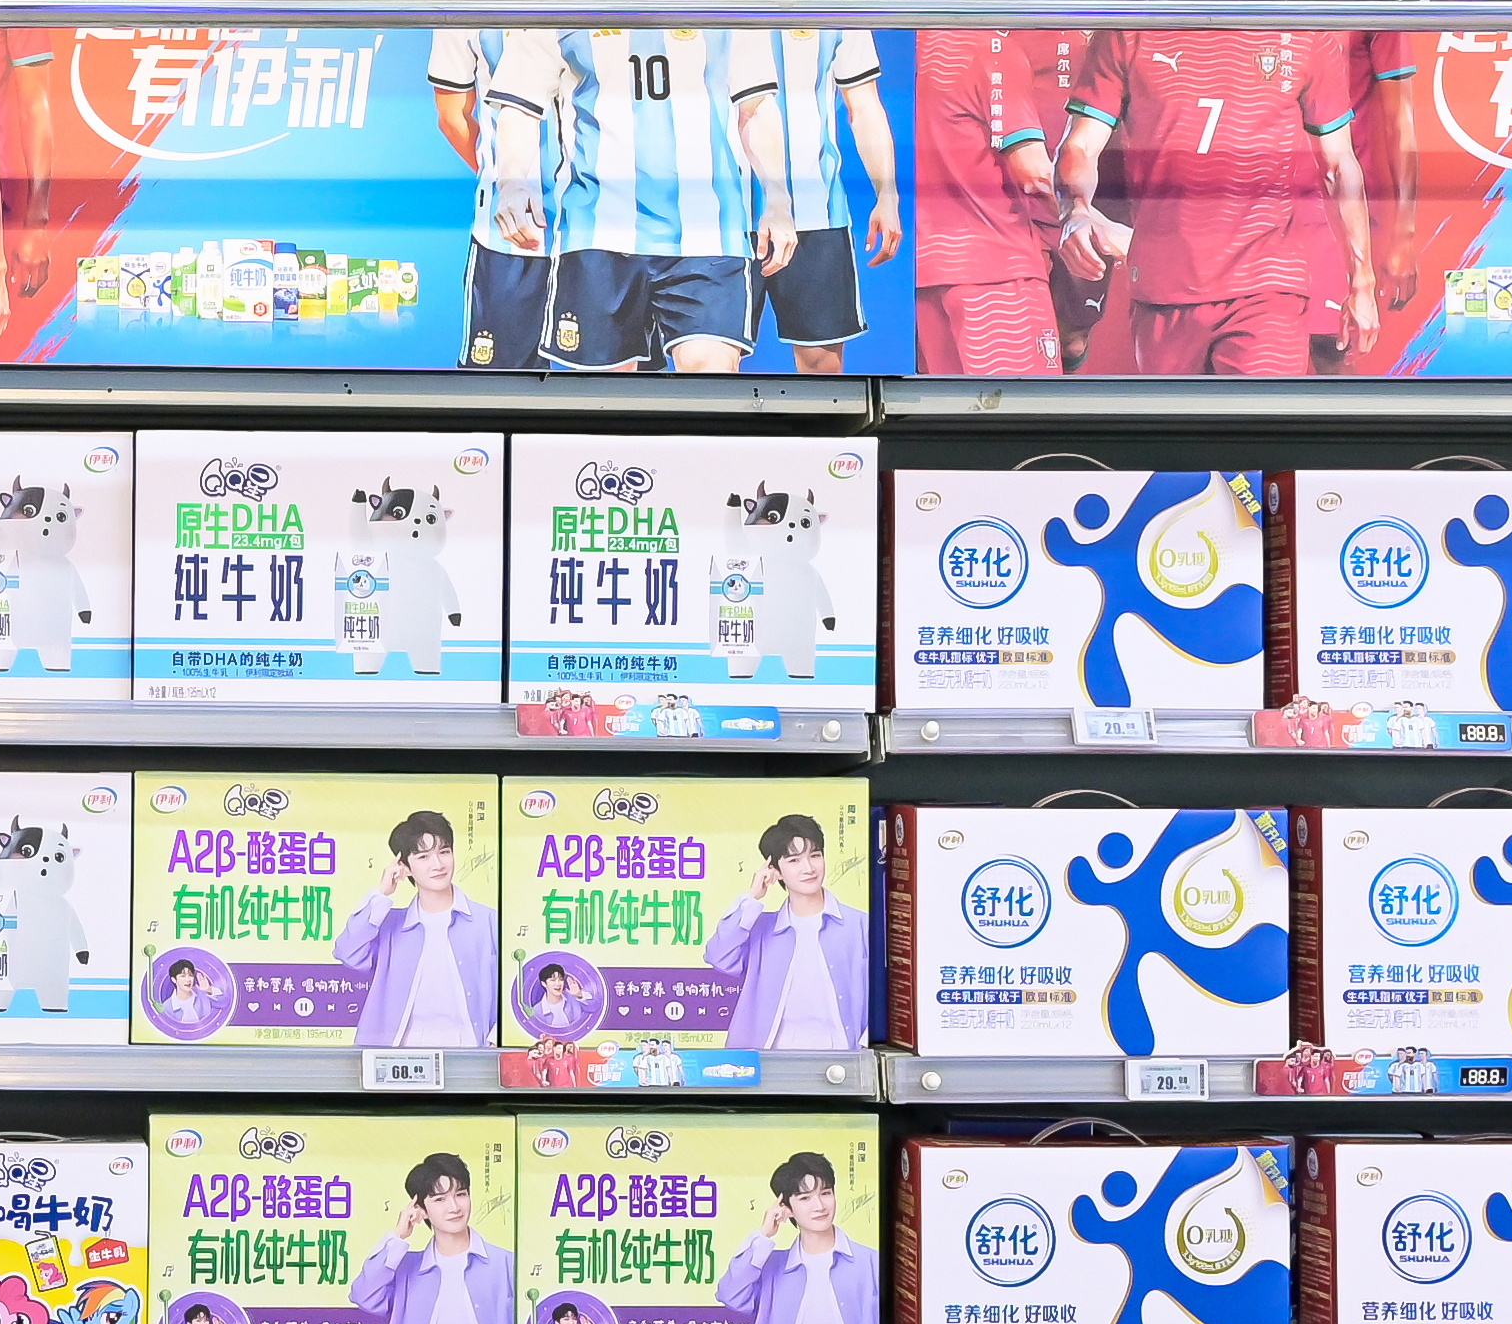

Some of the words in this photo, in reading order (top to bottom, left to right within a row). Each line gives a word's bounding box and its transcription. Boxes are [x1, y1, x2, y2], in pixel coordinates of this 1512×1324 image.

[127, 46, 369, 131] 有伊利
[630, 55, 671, 102] 10
[1195, 99, 1225, 155] 7
[946, 544, 1010, 581] 舒化
[1347, 544, 1411, 581] 舒化
[548, 557, 680, 628] 纯牛奶
[918, 626, 993, 646] 营养细化
[997, 626, 1050, 646] 好吸收
[172, 886, 333, 943] 有机纯牛奶
[968, 882, 1034, 919] 舒化
[1375, 882, 1441, 919] 舒化
[86, 1242, 129, 1266] 生牛乳
[188, 1228, 350, 1288] 有机纯牛奶
[553, 1228, 715, 1288] 有机纯牛奶
